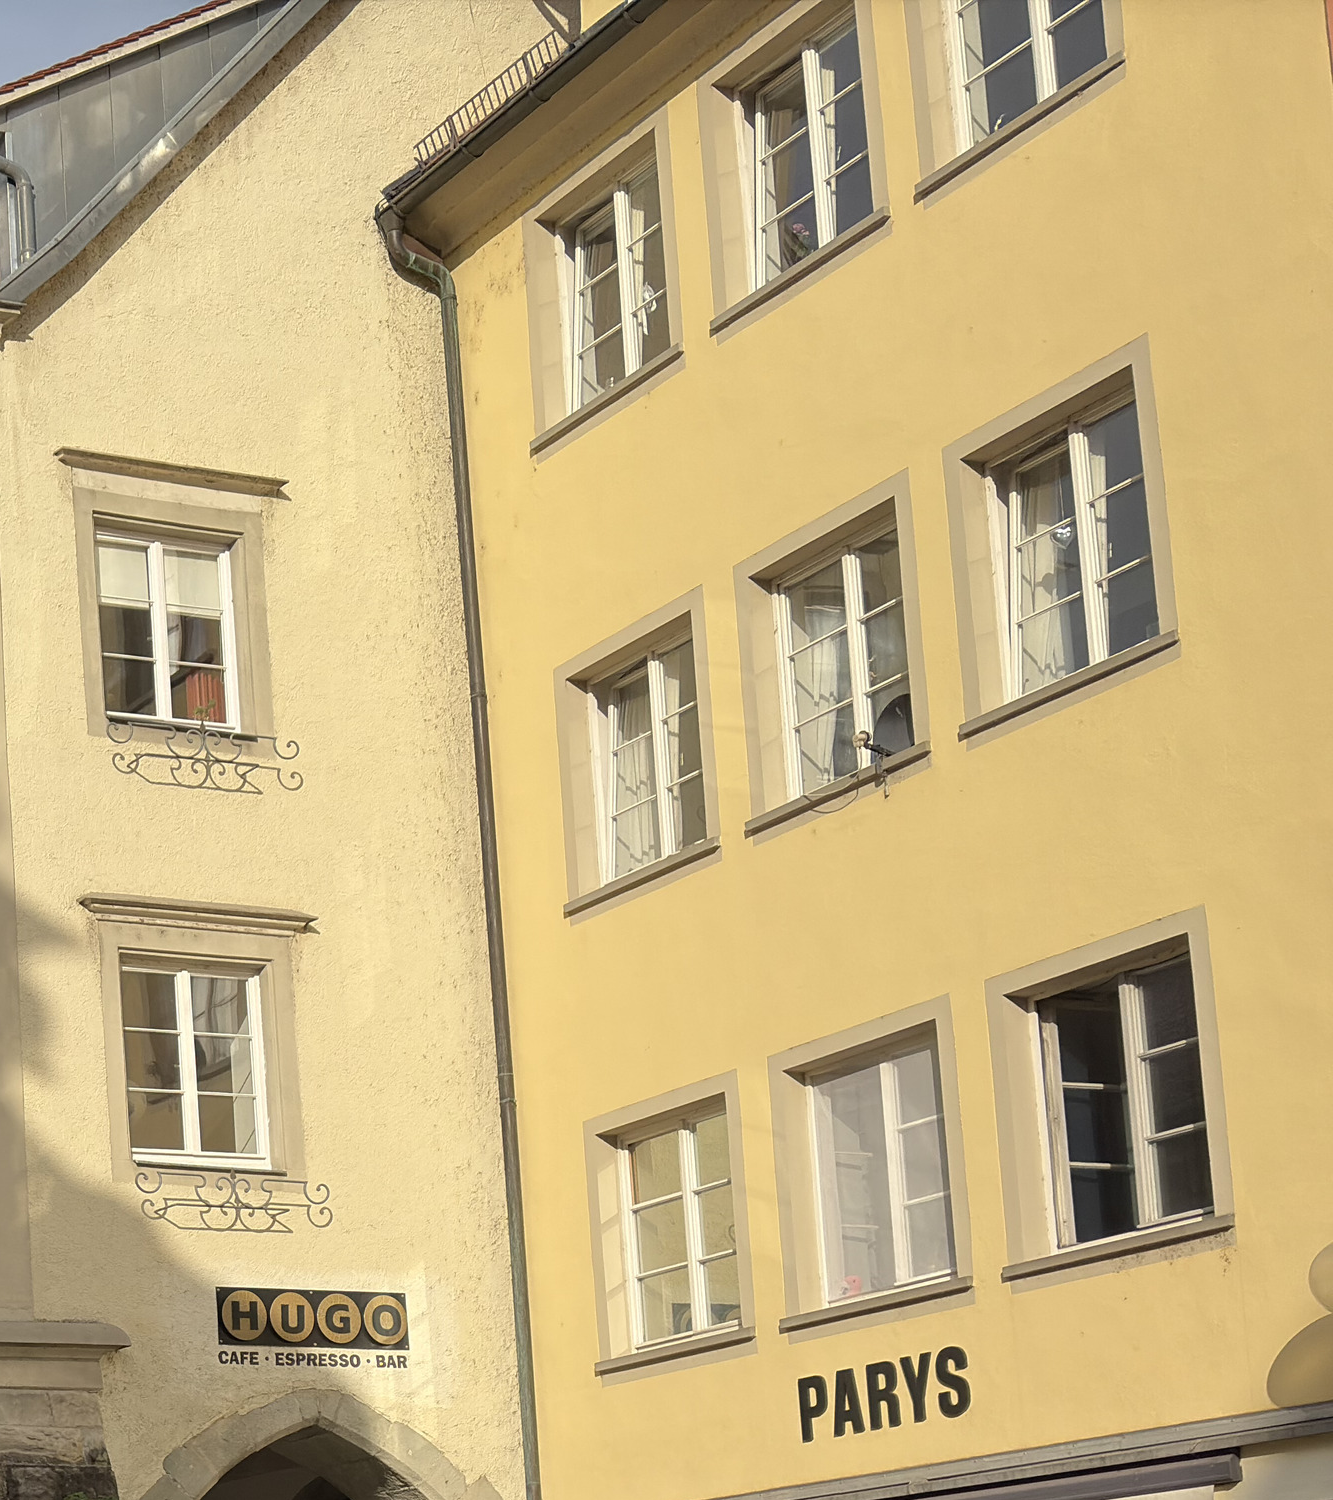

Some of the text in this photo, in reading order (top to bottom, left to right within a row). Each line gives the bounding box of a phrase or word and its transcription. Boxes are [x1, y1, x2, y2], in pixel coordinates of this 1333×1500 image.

[226, 1295, 404, 1341] HUGO
[218, 1351, 408, 1369] CAFE ESPRESSO BAR
[797, 1346, 971, 1443] PARYS
